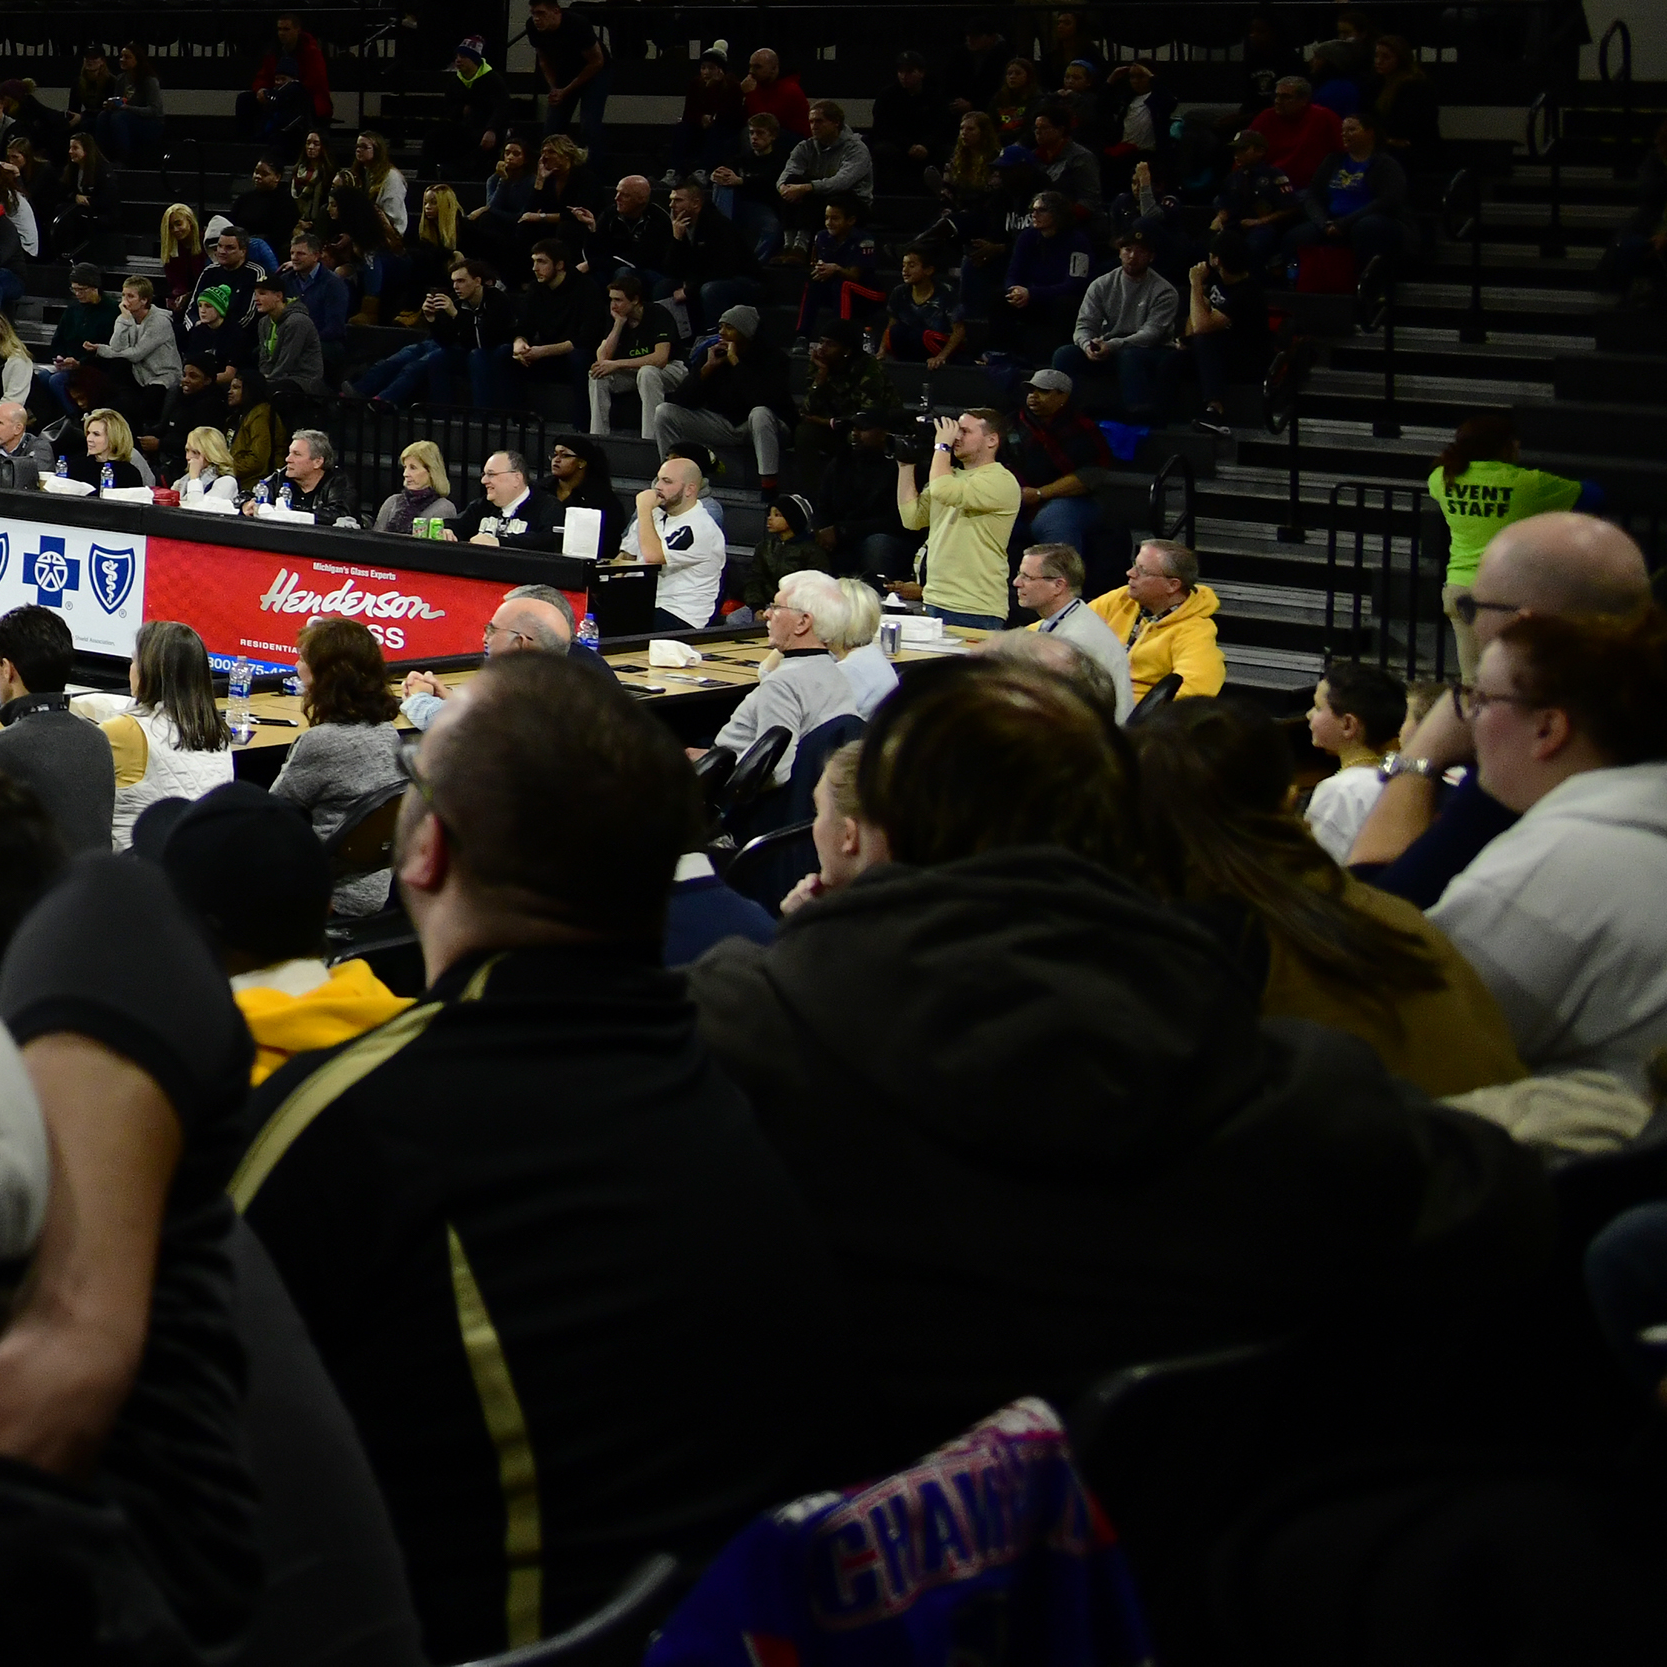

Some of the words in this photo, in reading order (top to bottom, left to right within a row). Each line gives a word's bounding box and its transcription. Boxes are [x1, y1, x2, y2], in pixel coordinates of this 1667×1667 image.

[629, 347, 649, 357] CAN
[1445, 483, 1513, 501] EVENT
[1447, 500, 1509, 517] STAFF
[313, 562, 349, 575] Michigan's
[350, 567, 369, 577] Glass
[370, 569, 396, 581] Experts
[259, 568, 446, 620] Henderson
[240, 639, 299, 655] RESIDENTIA
